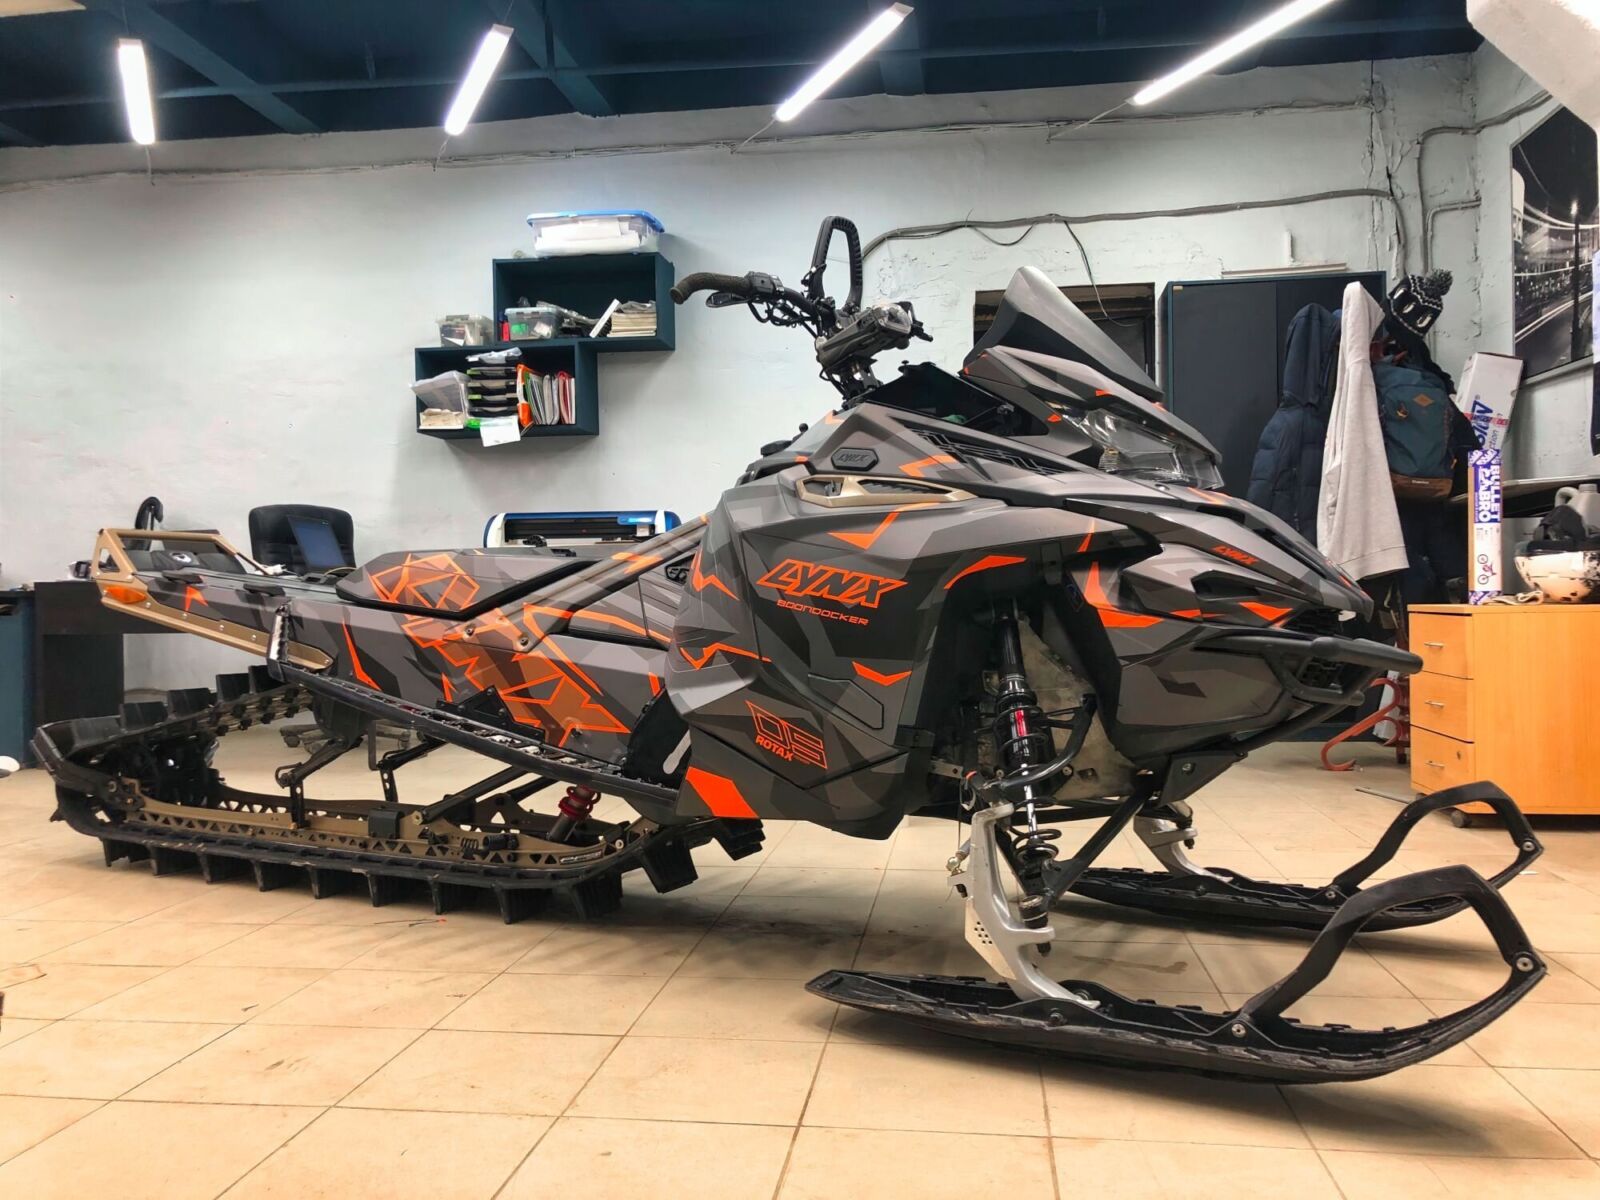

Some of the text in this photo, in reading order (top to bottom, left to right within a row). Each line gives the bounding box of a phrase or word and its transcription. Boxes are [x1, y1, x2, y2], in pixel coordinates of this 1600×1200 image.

[1490, 465, 1501, 523] BULLET
[756, 558, 908, 609] LYNX
[776, 599, 870, 626] BOONDOCKER
[756, 735, 794, 761] ROTAX
